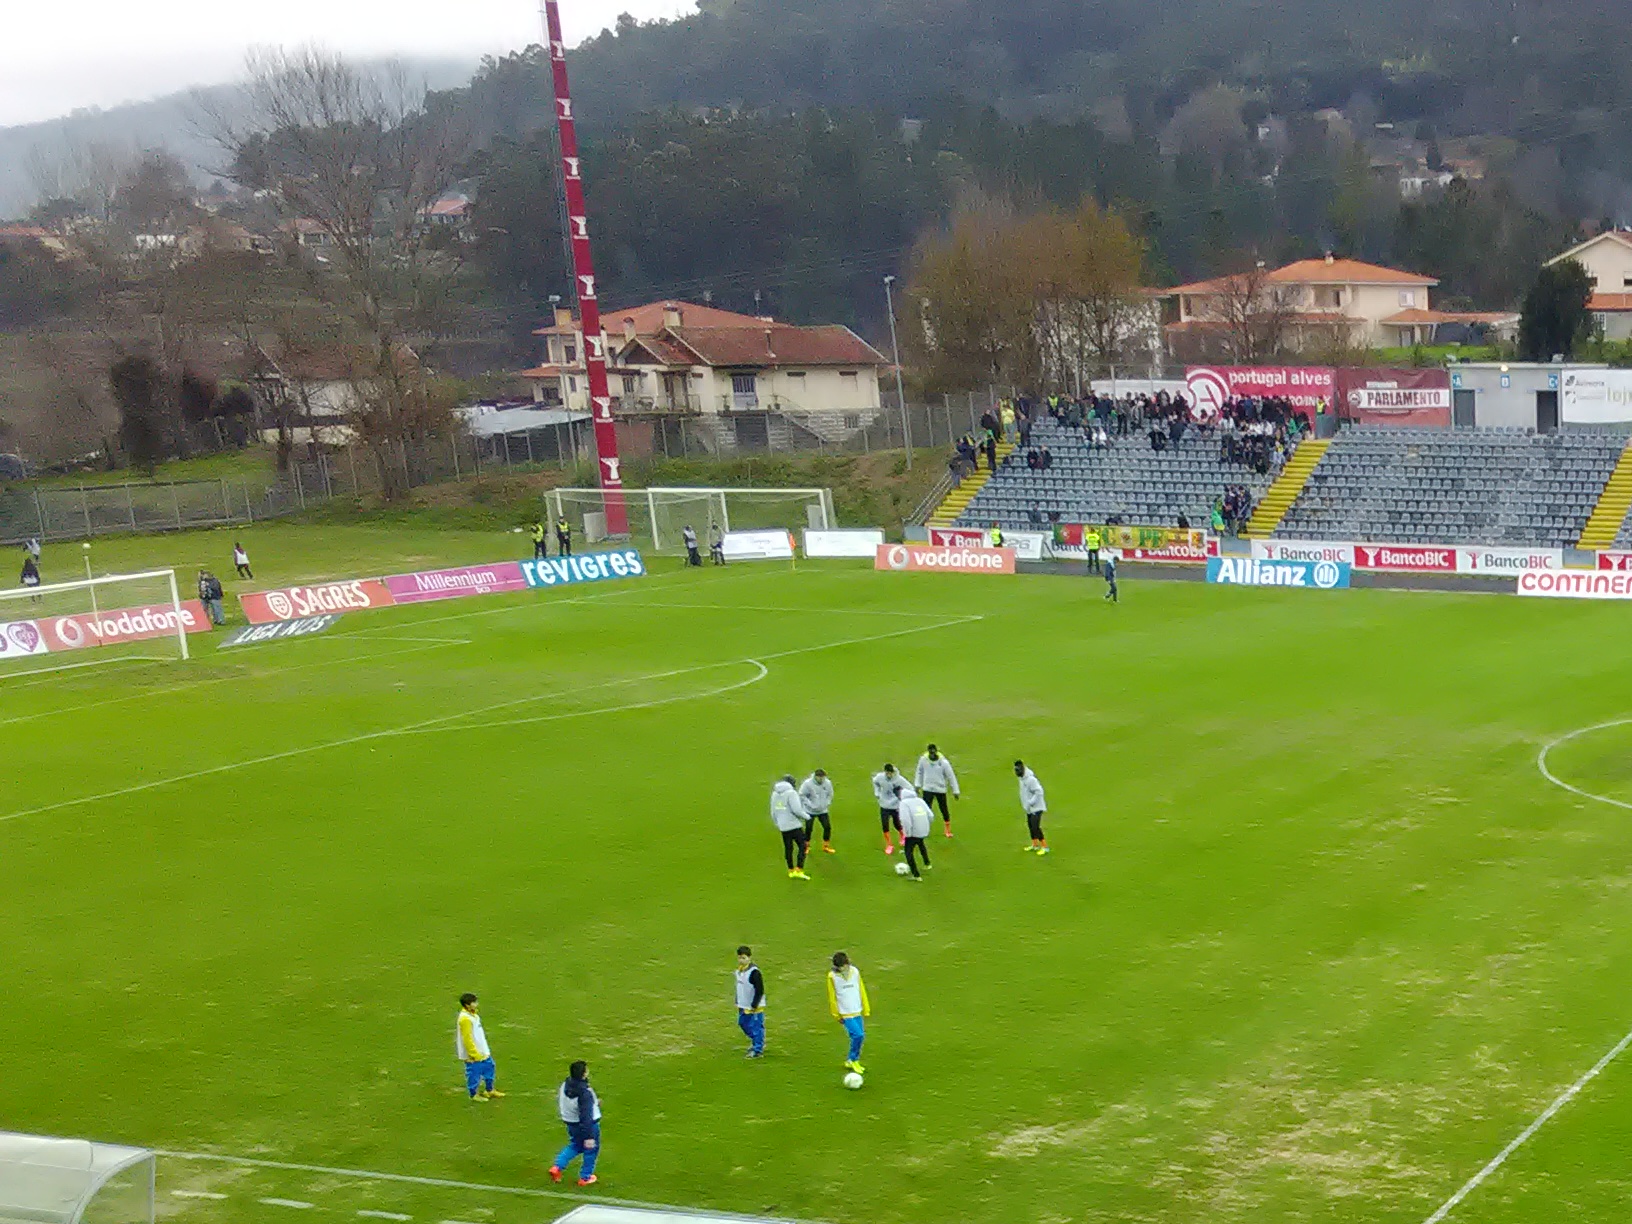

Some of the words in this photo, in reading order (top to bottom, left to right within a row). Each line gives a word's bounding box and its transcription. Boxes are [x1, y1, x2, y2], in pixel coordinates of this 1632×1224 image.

[1228, 370, 1287, 387] portugal
[1290, 370, 1331, 385] alves
[1367, 391, 1441, 406] PARLAMENTO
[914, 547, 1003, 568] vodafone
[1280, 546, 1346, 561] BancoBIC
[1380, 549, 1449, 567] BancoBIC
[1484, 553, 1552, 569] BancoBIC
[414, 570, 498, 592] Millennium
[1217, 559, 1306, 586] Allianz
[290, 581, 371, 616] SAGRES
[87, 606, 196, 638] vodafone
[235, 622, 284, 645] LIGA
